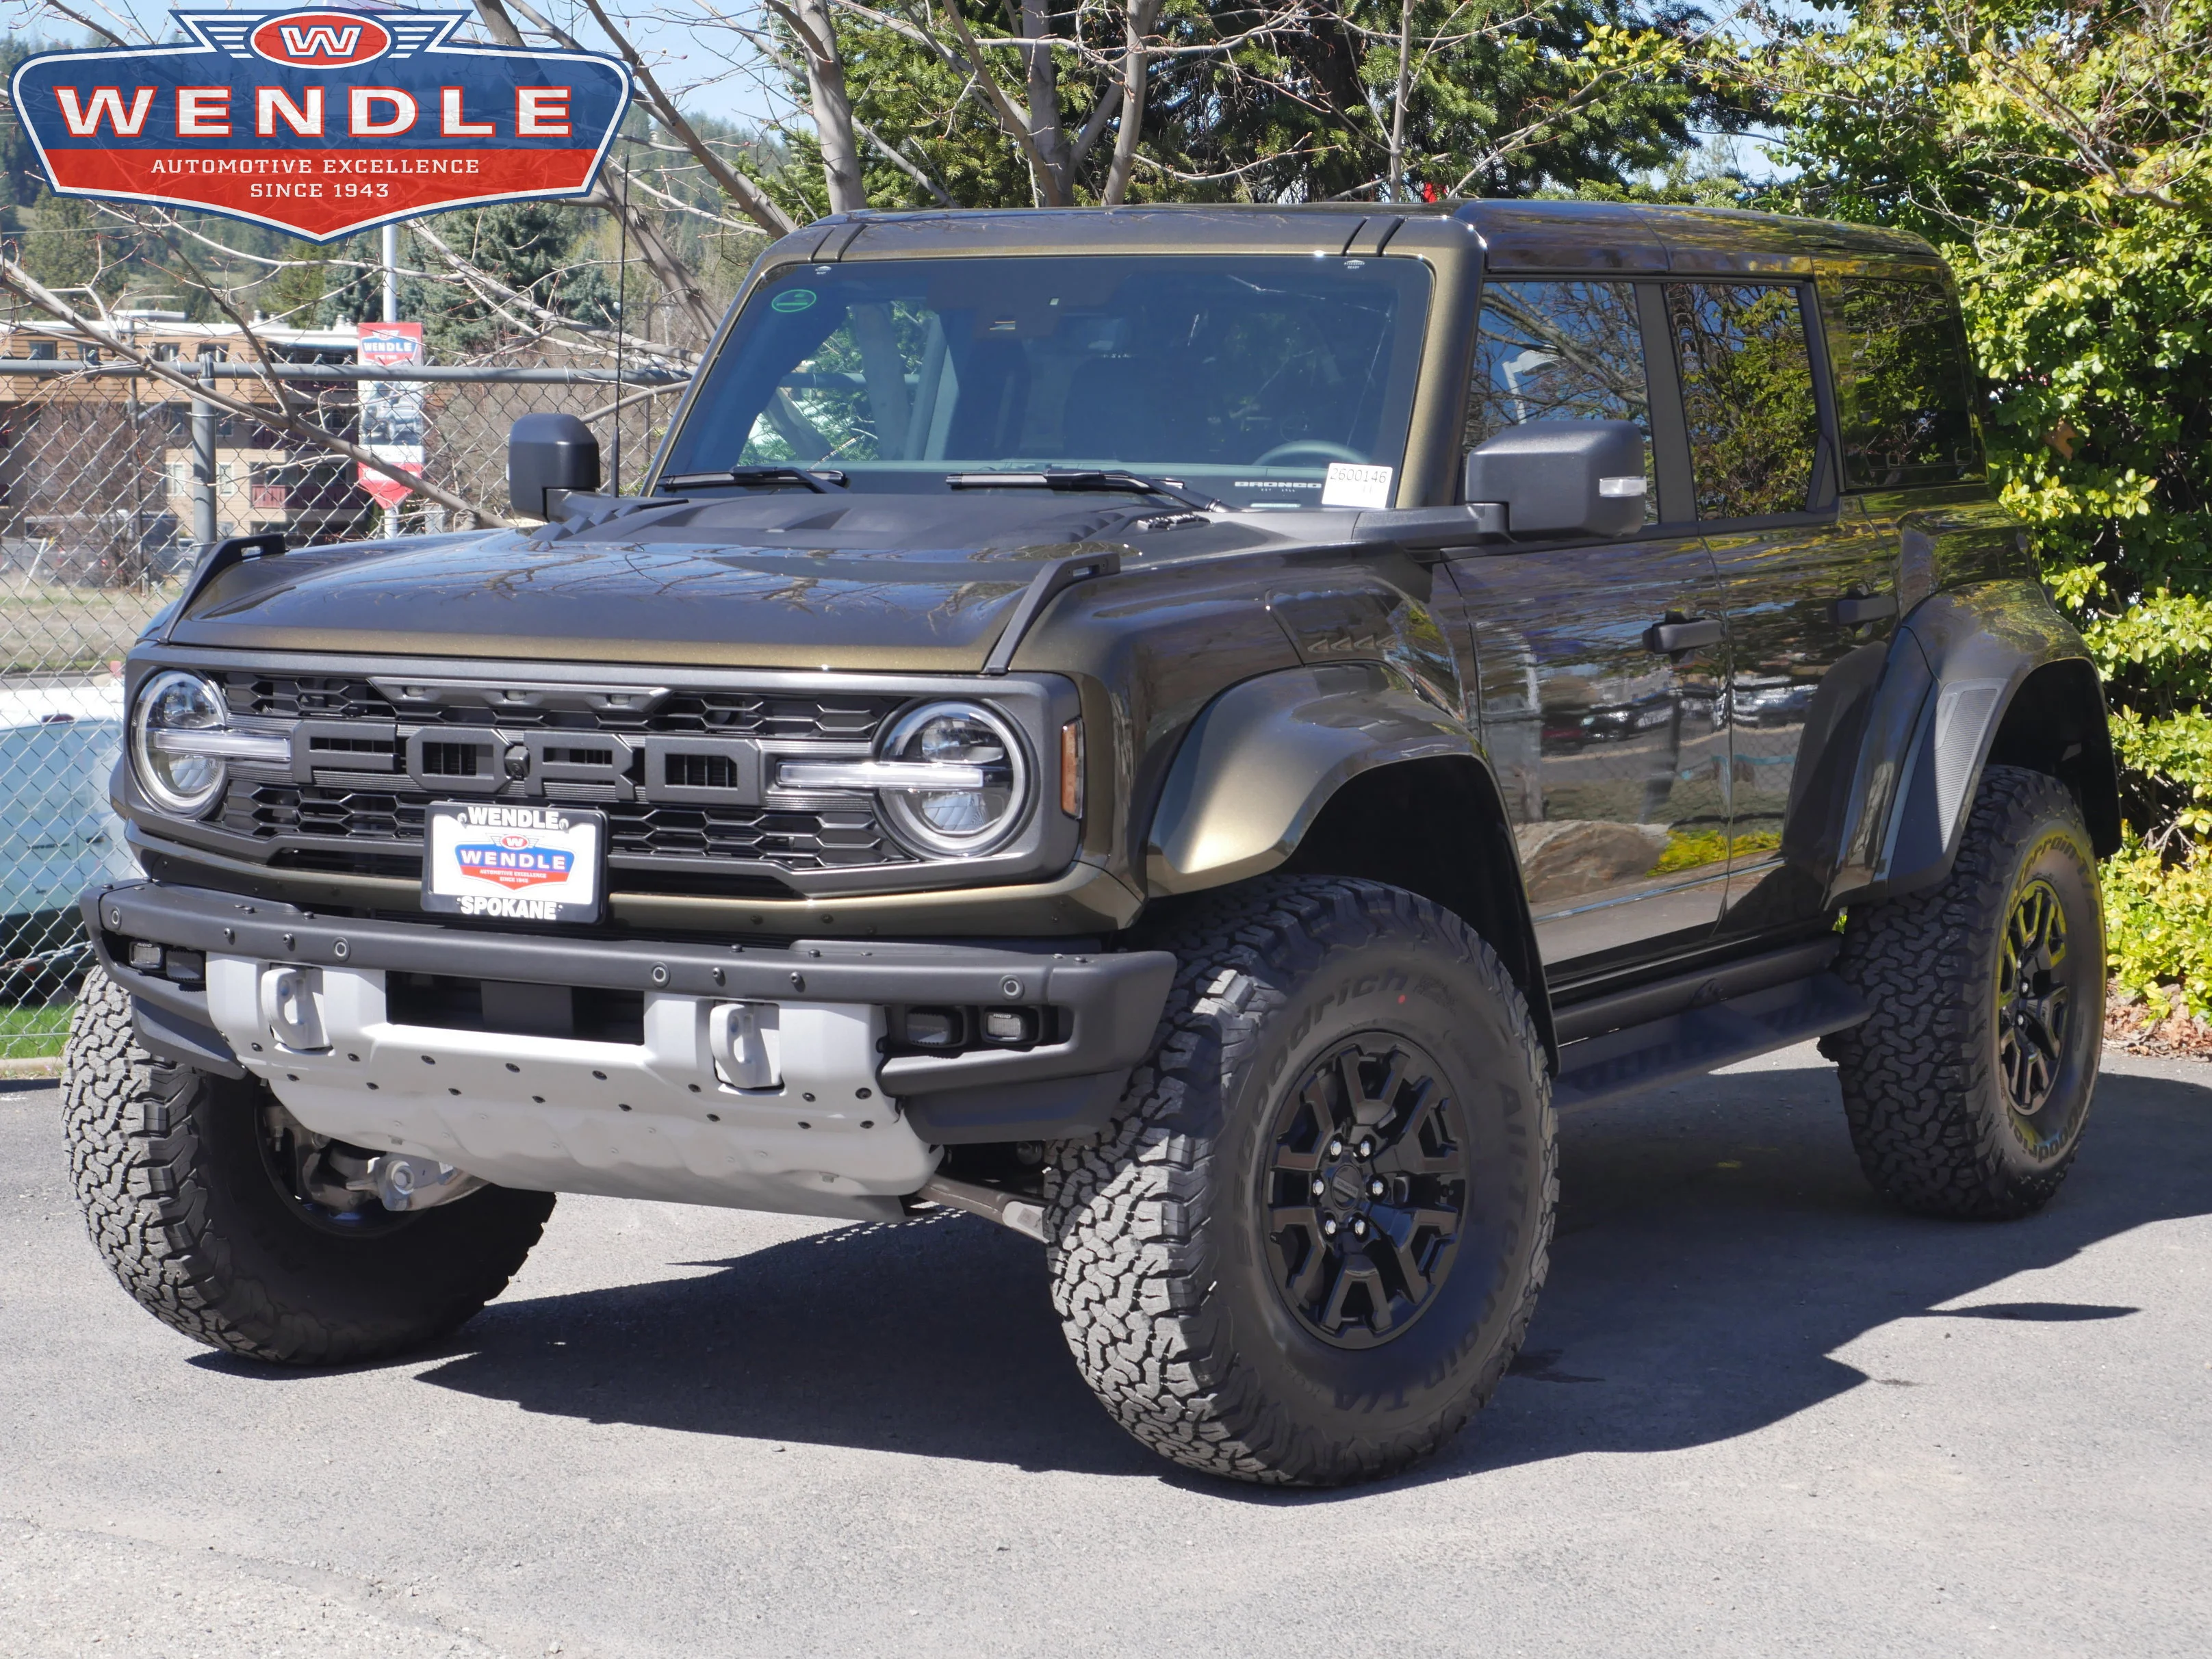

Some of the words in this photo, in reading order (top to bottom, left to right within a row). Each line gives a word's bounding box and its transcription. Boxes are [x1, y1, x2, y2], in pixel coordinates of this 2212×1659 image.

[363, 342, 412, 352] WENDLE
[1330, 467, 1387, 483] 2600146
[290, 719, 760, 807] FORD
[467, 807, 559, 830] WENDLE
[461, 849, 565, 870] WENDLE
[459, 896, 558, 920] SPOKANE
